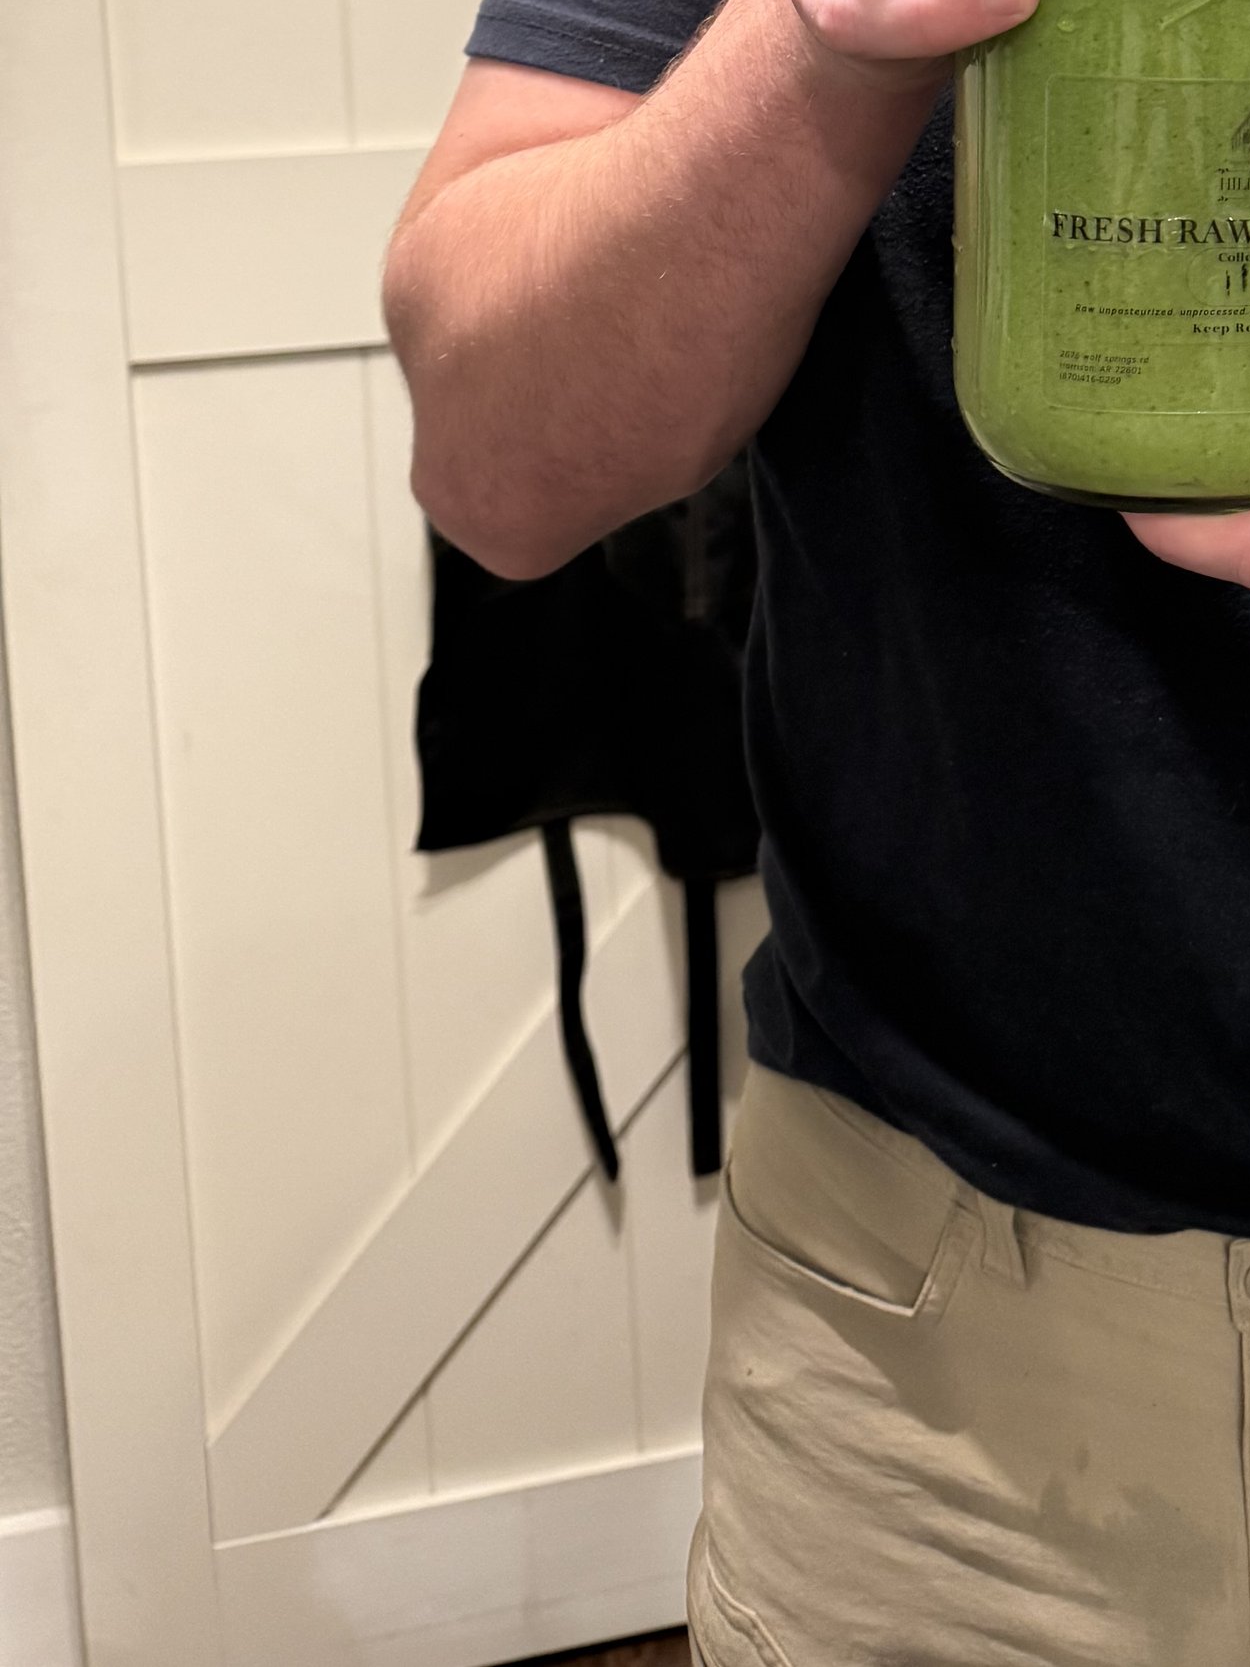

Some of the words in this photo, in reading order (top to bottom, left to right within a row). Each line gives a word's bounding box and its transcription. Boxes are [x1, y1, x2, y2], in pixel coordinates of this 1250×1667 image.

[1052, 212, 1164, 244] FRESH
[1075, 303, 1096, 313] Raw
[1193, 323, 1231, 335] Keep
[1104, 355, 1137, 365] springs
[1099, 365, 1112, 373] AR
